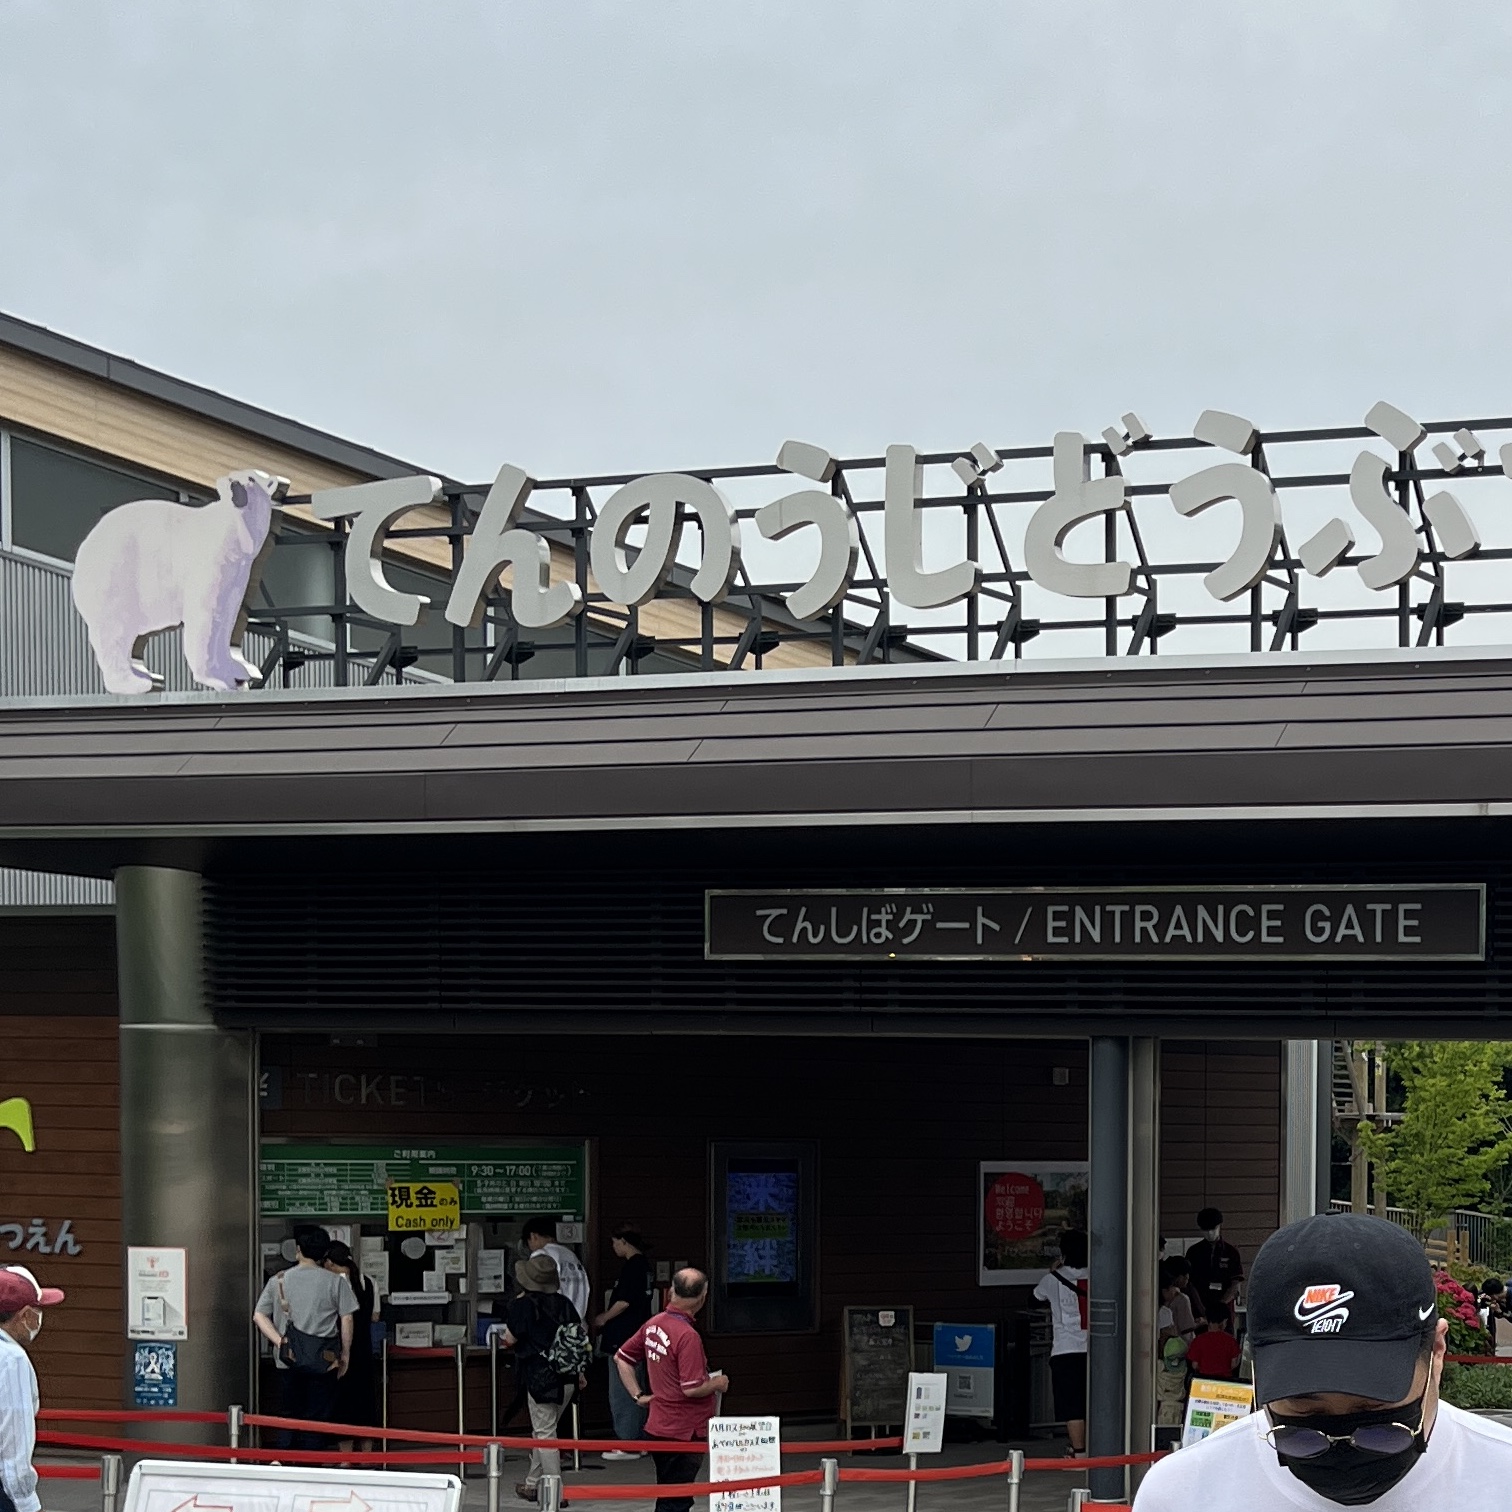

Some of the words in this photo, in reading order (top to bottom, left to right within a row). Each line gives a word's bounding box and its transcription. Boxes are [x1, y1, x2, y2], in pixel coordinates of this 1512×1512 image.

[755, 904, 1001, 946] てんしばゲート
[1046, 903, 1285, 945] ENTRANCE
[1304, 903, 1423, 945] GATE
[389, 1186, 458, 1209] 現金のみ
[395, 1216, 428, 1228] Cash
[431, 1216, 455, 1230] only
[1305, 1288, 1337, 1303] NIKE
